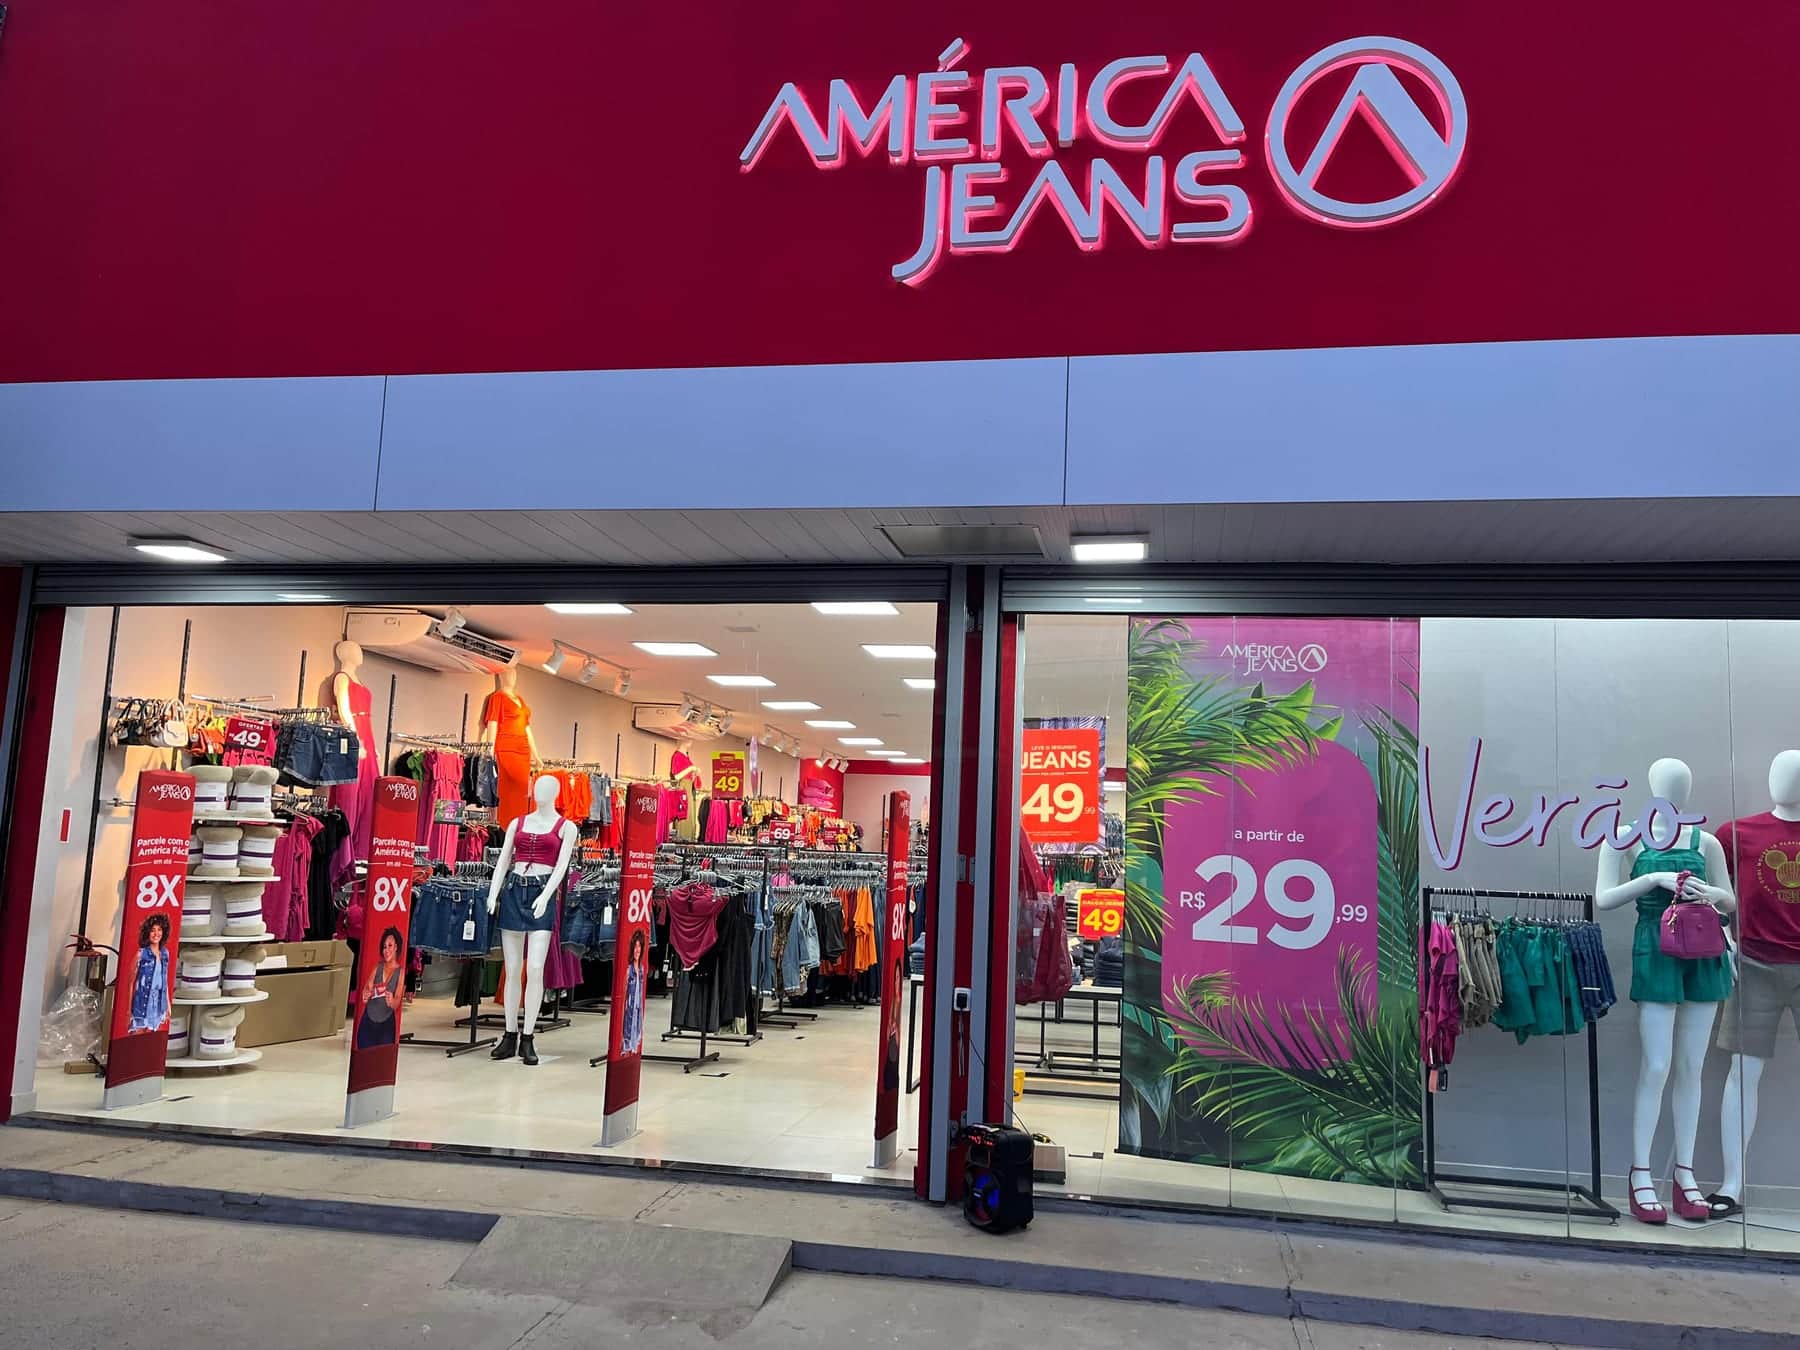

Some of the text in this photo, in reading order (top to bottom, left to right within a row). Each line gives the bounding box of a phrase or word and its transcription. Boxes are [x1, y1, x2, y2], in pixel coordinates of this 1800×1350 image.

[740, 38, 1244, 171] AMÉRICA
[891, 150, 1252, 284] JEANS
[1220, 643, 1297, 659] AMÉRICA
[1243, 658, 1298, 676] JEANS
[232, 730, 262, 748] 49
[1021, 751, 1092, 769] JEANS
[714, 776, 740, 792] 49
[1021, 783, 1084, 823] 49
[1418, 735, 1707, 871] Verão
[137, 836, 167, 848] Parcele
[168, 838, 184, 846] com
[774, 828, 791, 840] 69
[1234, 829, 1305, 843] a partir de
[138, 846, 171, 857] América
[136, 874, 181, 908] 8X
[373, 876, 409, 912] 8X
[627, 888, 653, 923] 8X
[1180, 891, 1207, 911] R$
[1083, 908, 1121, 932] 49
